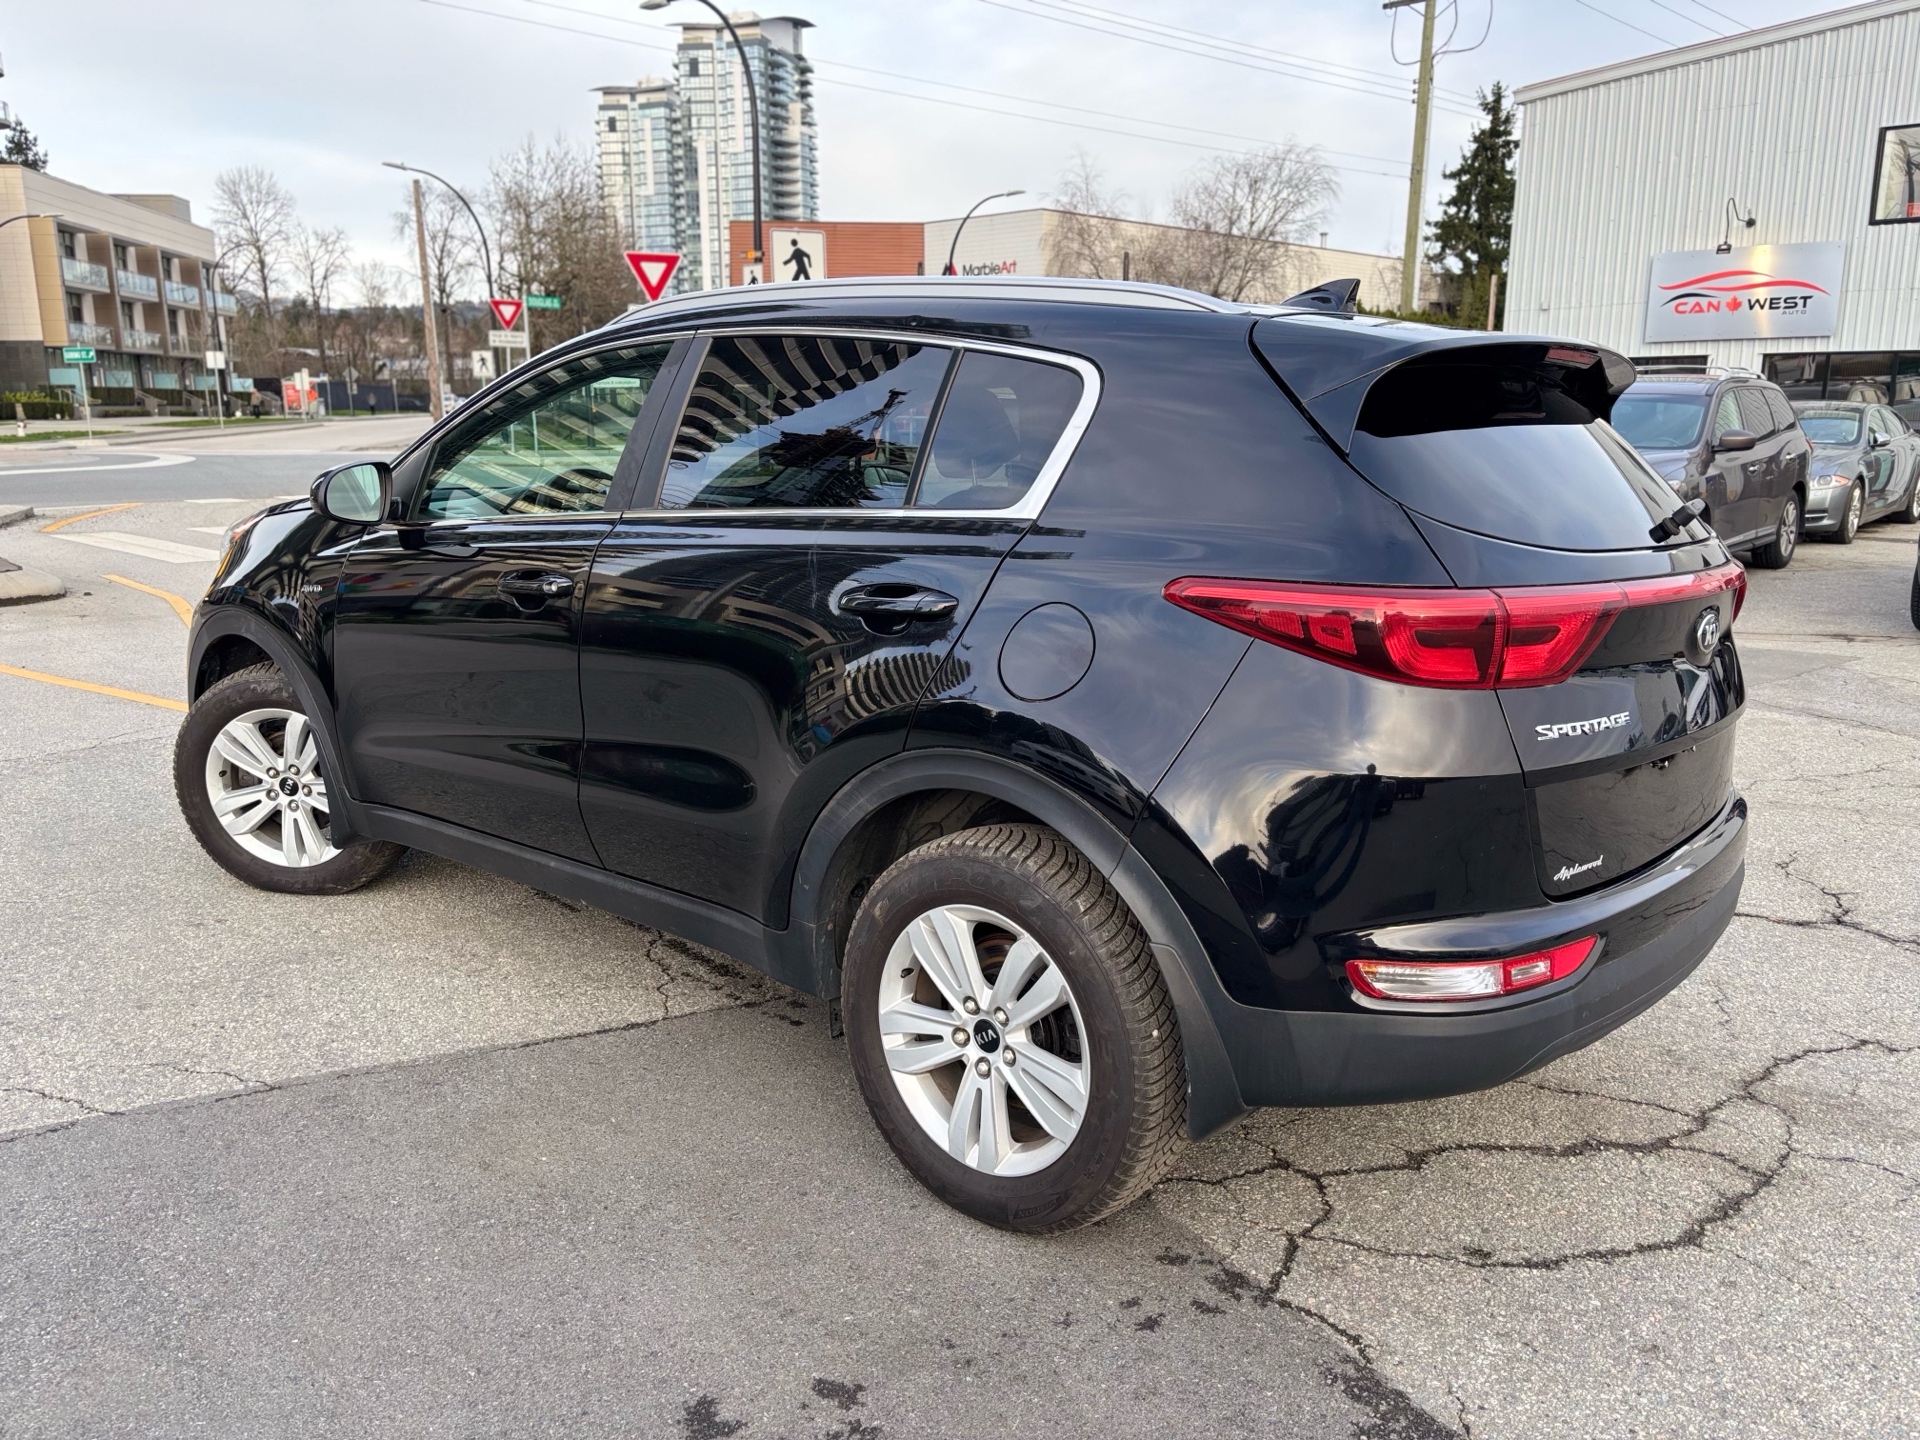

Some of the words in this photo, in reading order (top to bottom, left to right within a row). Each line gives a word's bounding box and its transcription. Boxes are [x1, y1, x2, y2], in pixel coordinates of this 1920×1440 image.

[962, 259, 1017, 276] MarbleArt
[1674, 300, 1721, 315] CAN
[1747, 295, 1814, 311] WEST
[1535, 711, 1631, 741] SPORTAGE
[283, 778, 294, 794] KIA
[1553, 854, 1604, 881] Applewood
[975, 1029, 997, 1046] KIA
